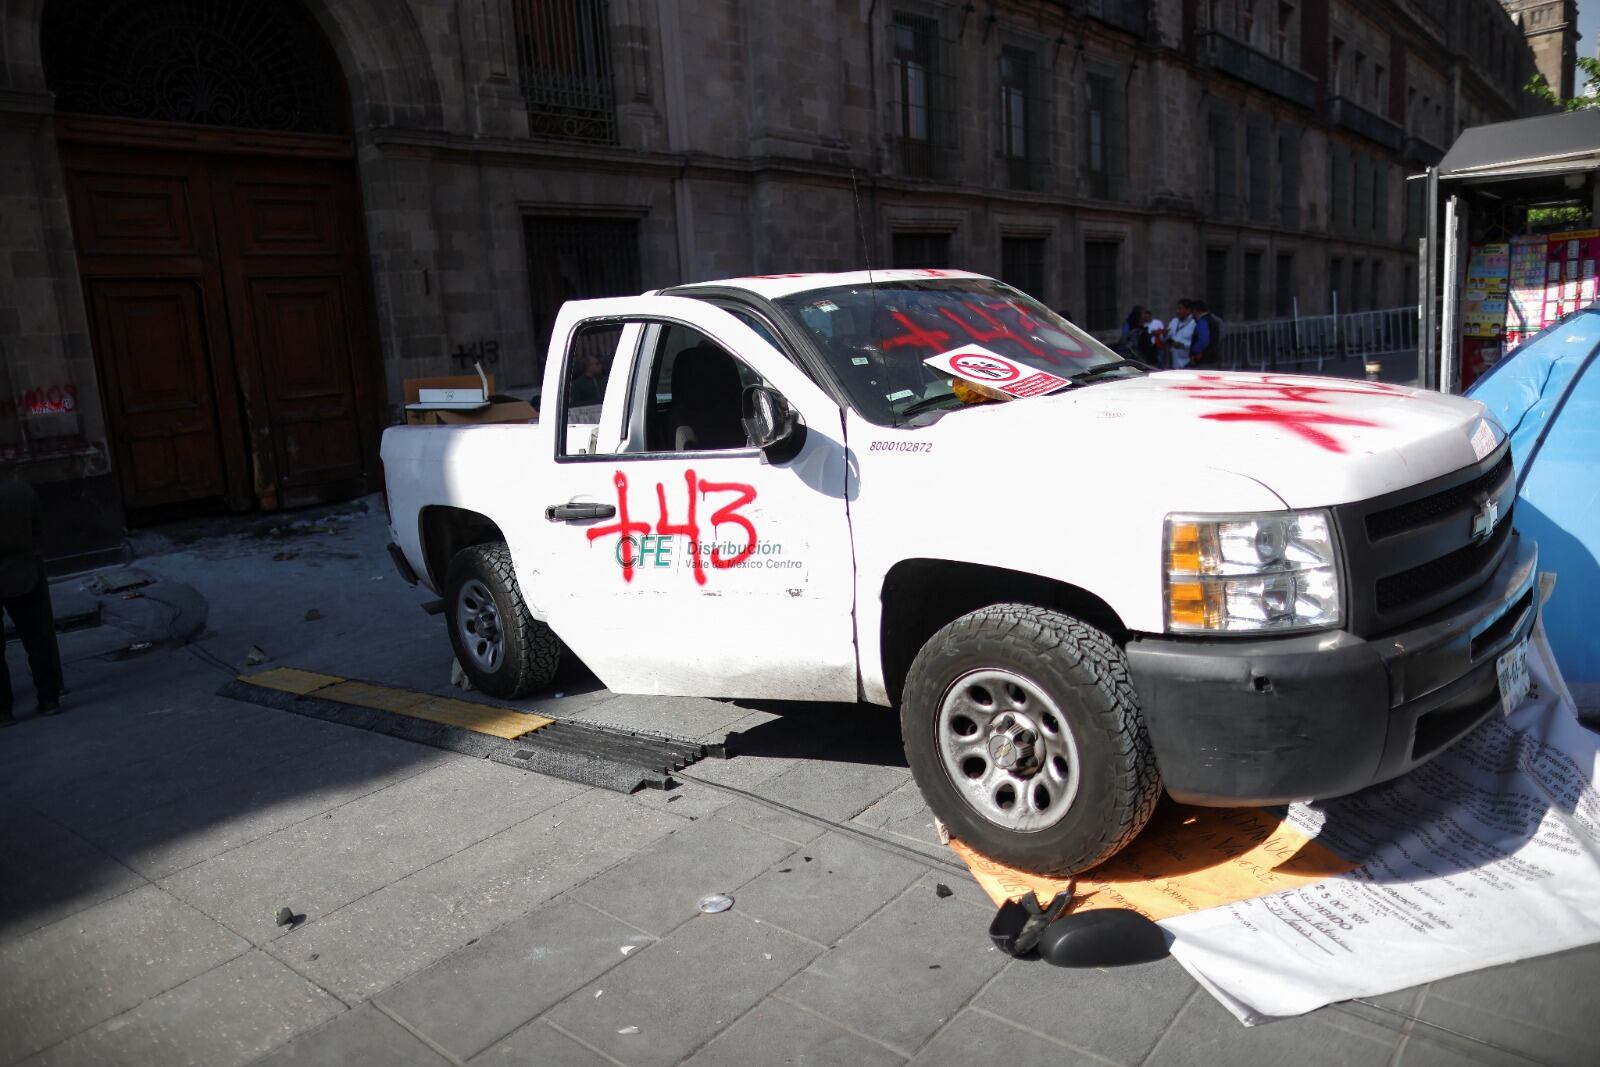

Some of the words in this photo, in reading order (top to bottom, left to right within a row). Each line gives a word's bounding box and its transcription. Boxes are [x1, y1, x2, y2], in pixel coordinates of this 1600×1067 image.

[869, 440, 933, 453] 8000102872
[586, 469, 757, 586] +43
[614, 534, 673, 569] CFE
[686, 540, 782, 556] Distribución
[685, 558, 710, 569] Valle
[712, 558, 725, 569] de
[727, 557, 763, 569] México
[765, 558, 803, 569] Centro
[1297, 889, 1353, 931] ECIBIDO
